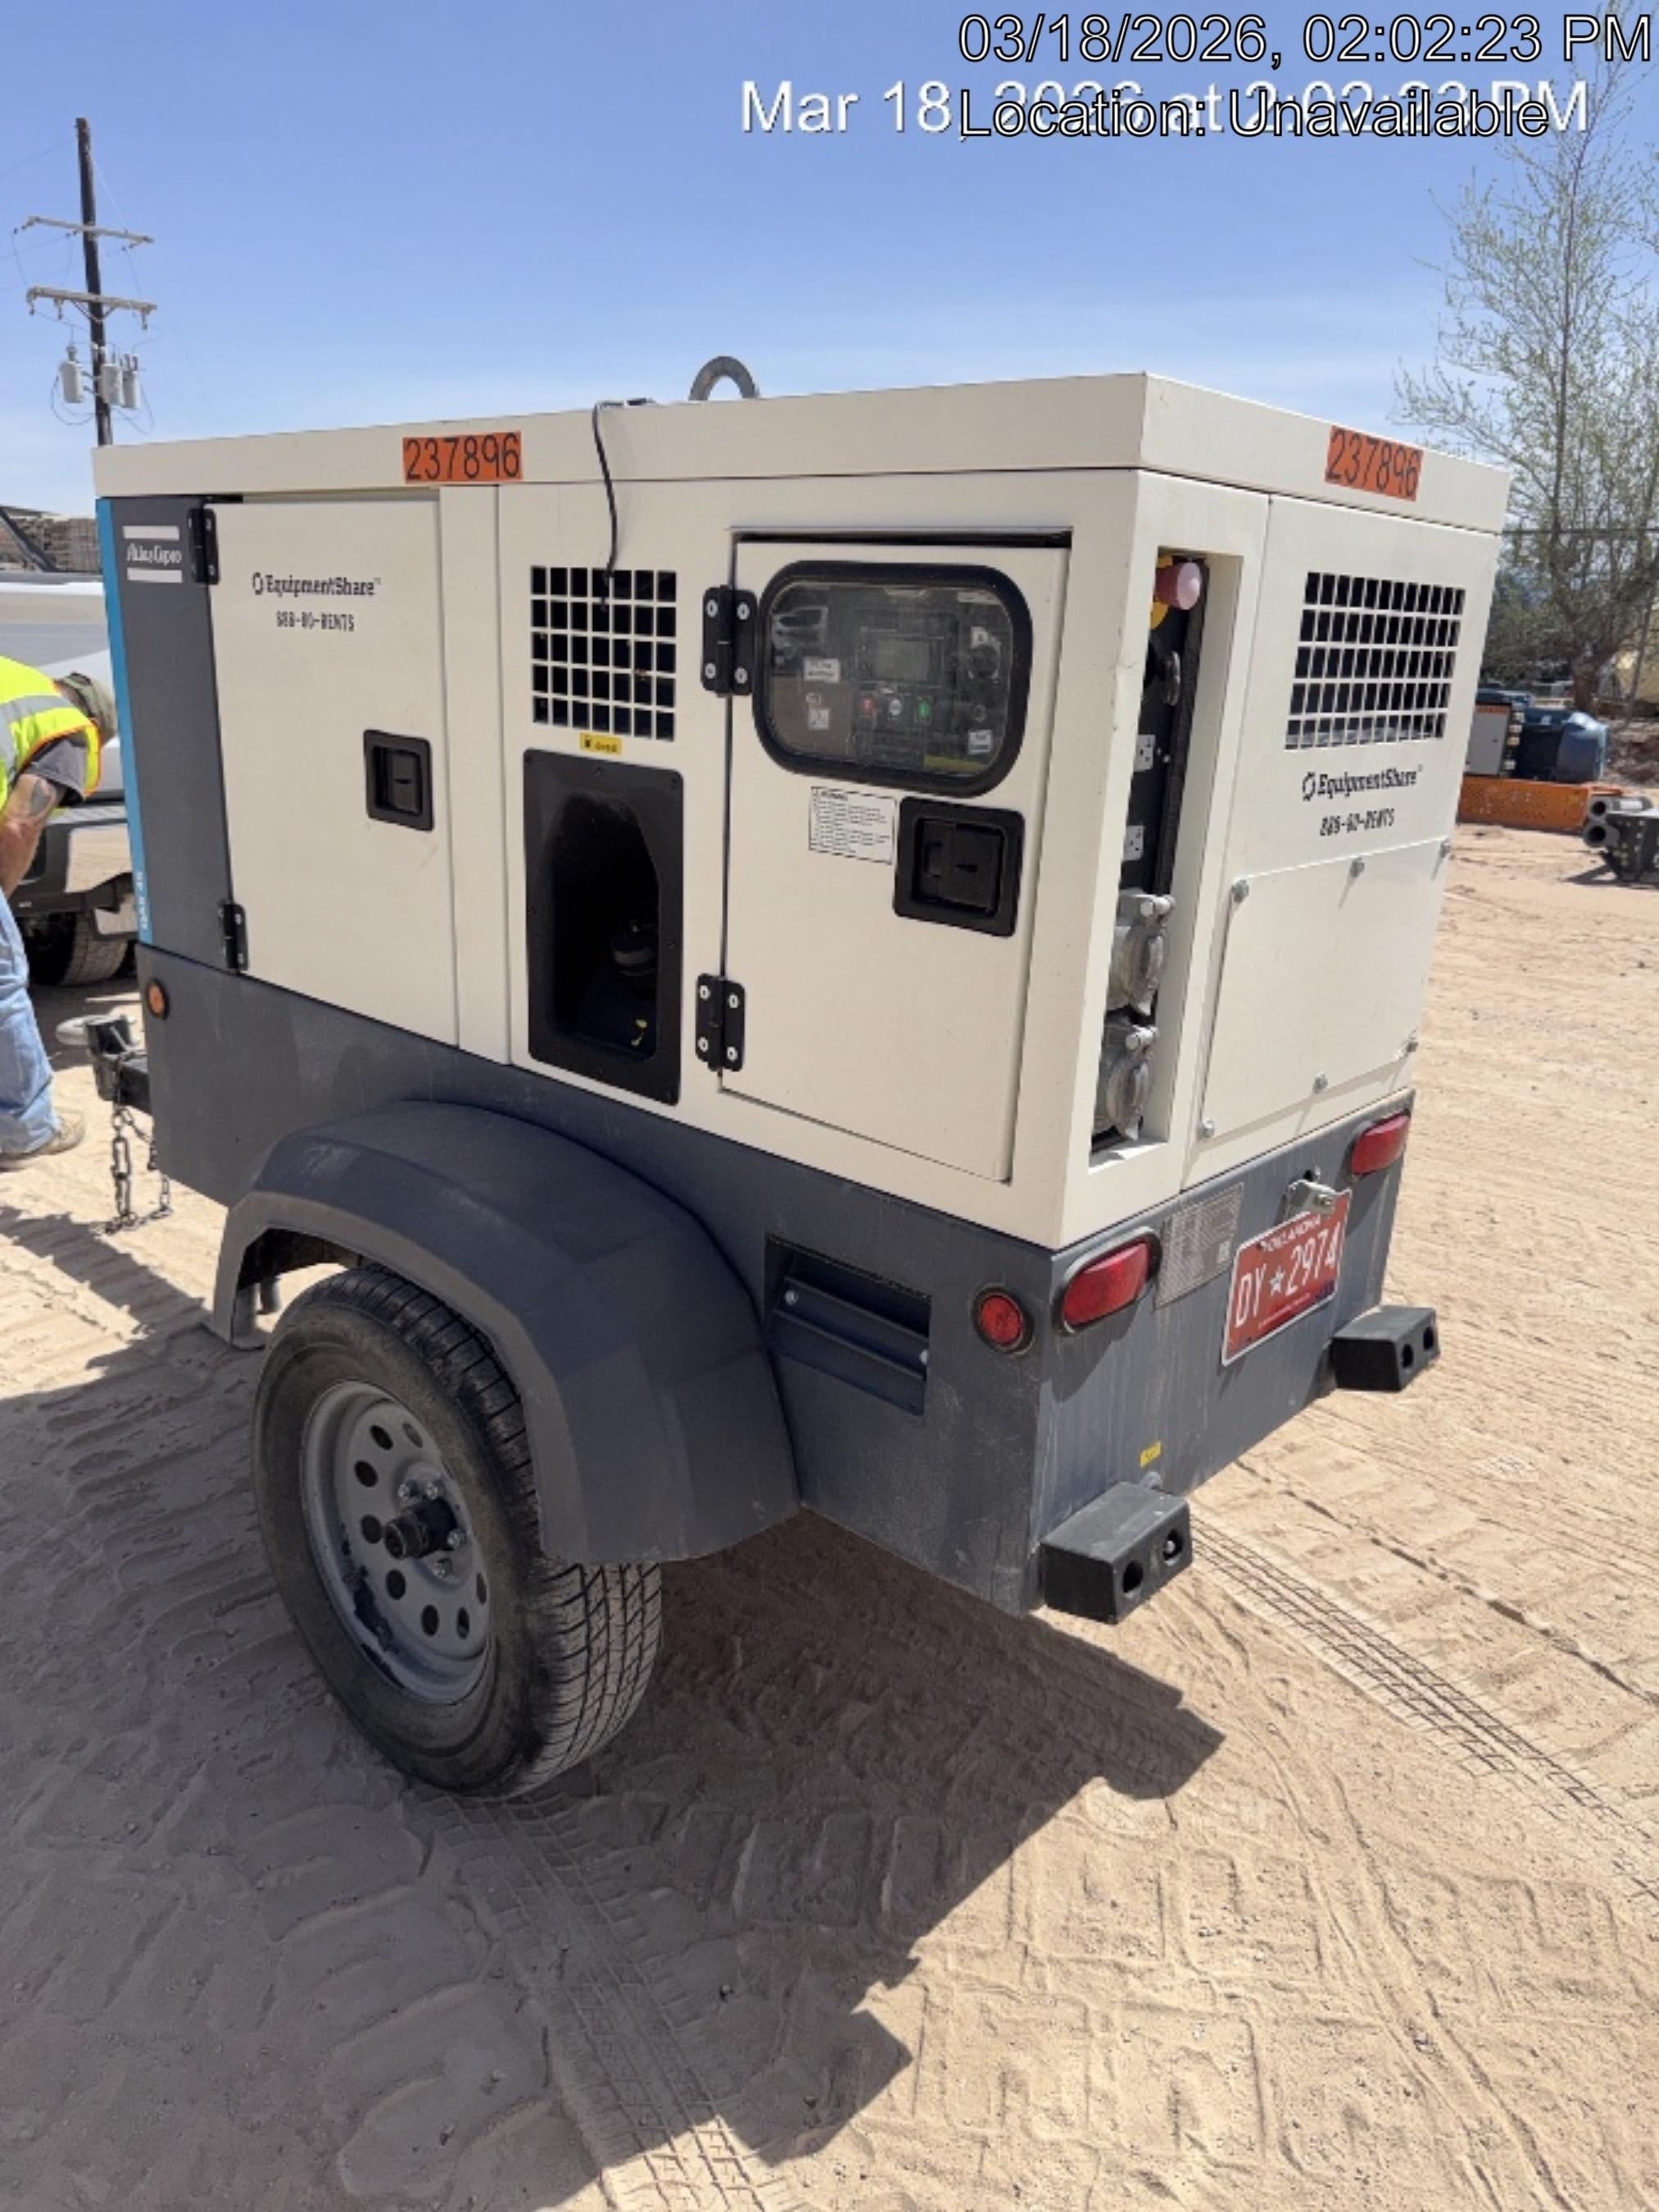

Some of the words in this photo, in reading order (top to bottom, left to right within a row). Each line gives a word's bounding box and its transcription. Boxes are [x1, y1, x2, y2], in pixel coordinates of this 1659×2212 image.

[406, 433, 519, 479] 237896
[1326, 428, 1421, 496] 237896
[1285, 1221, 1341, 1296] 2974
